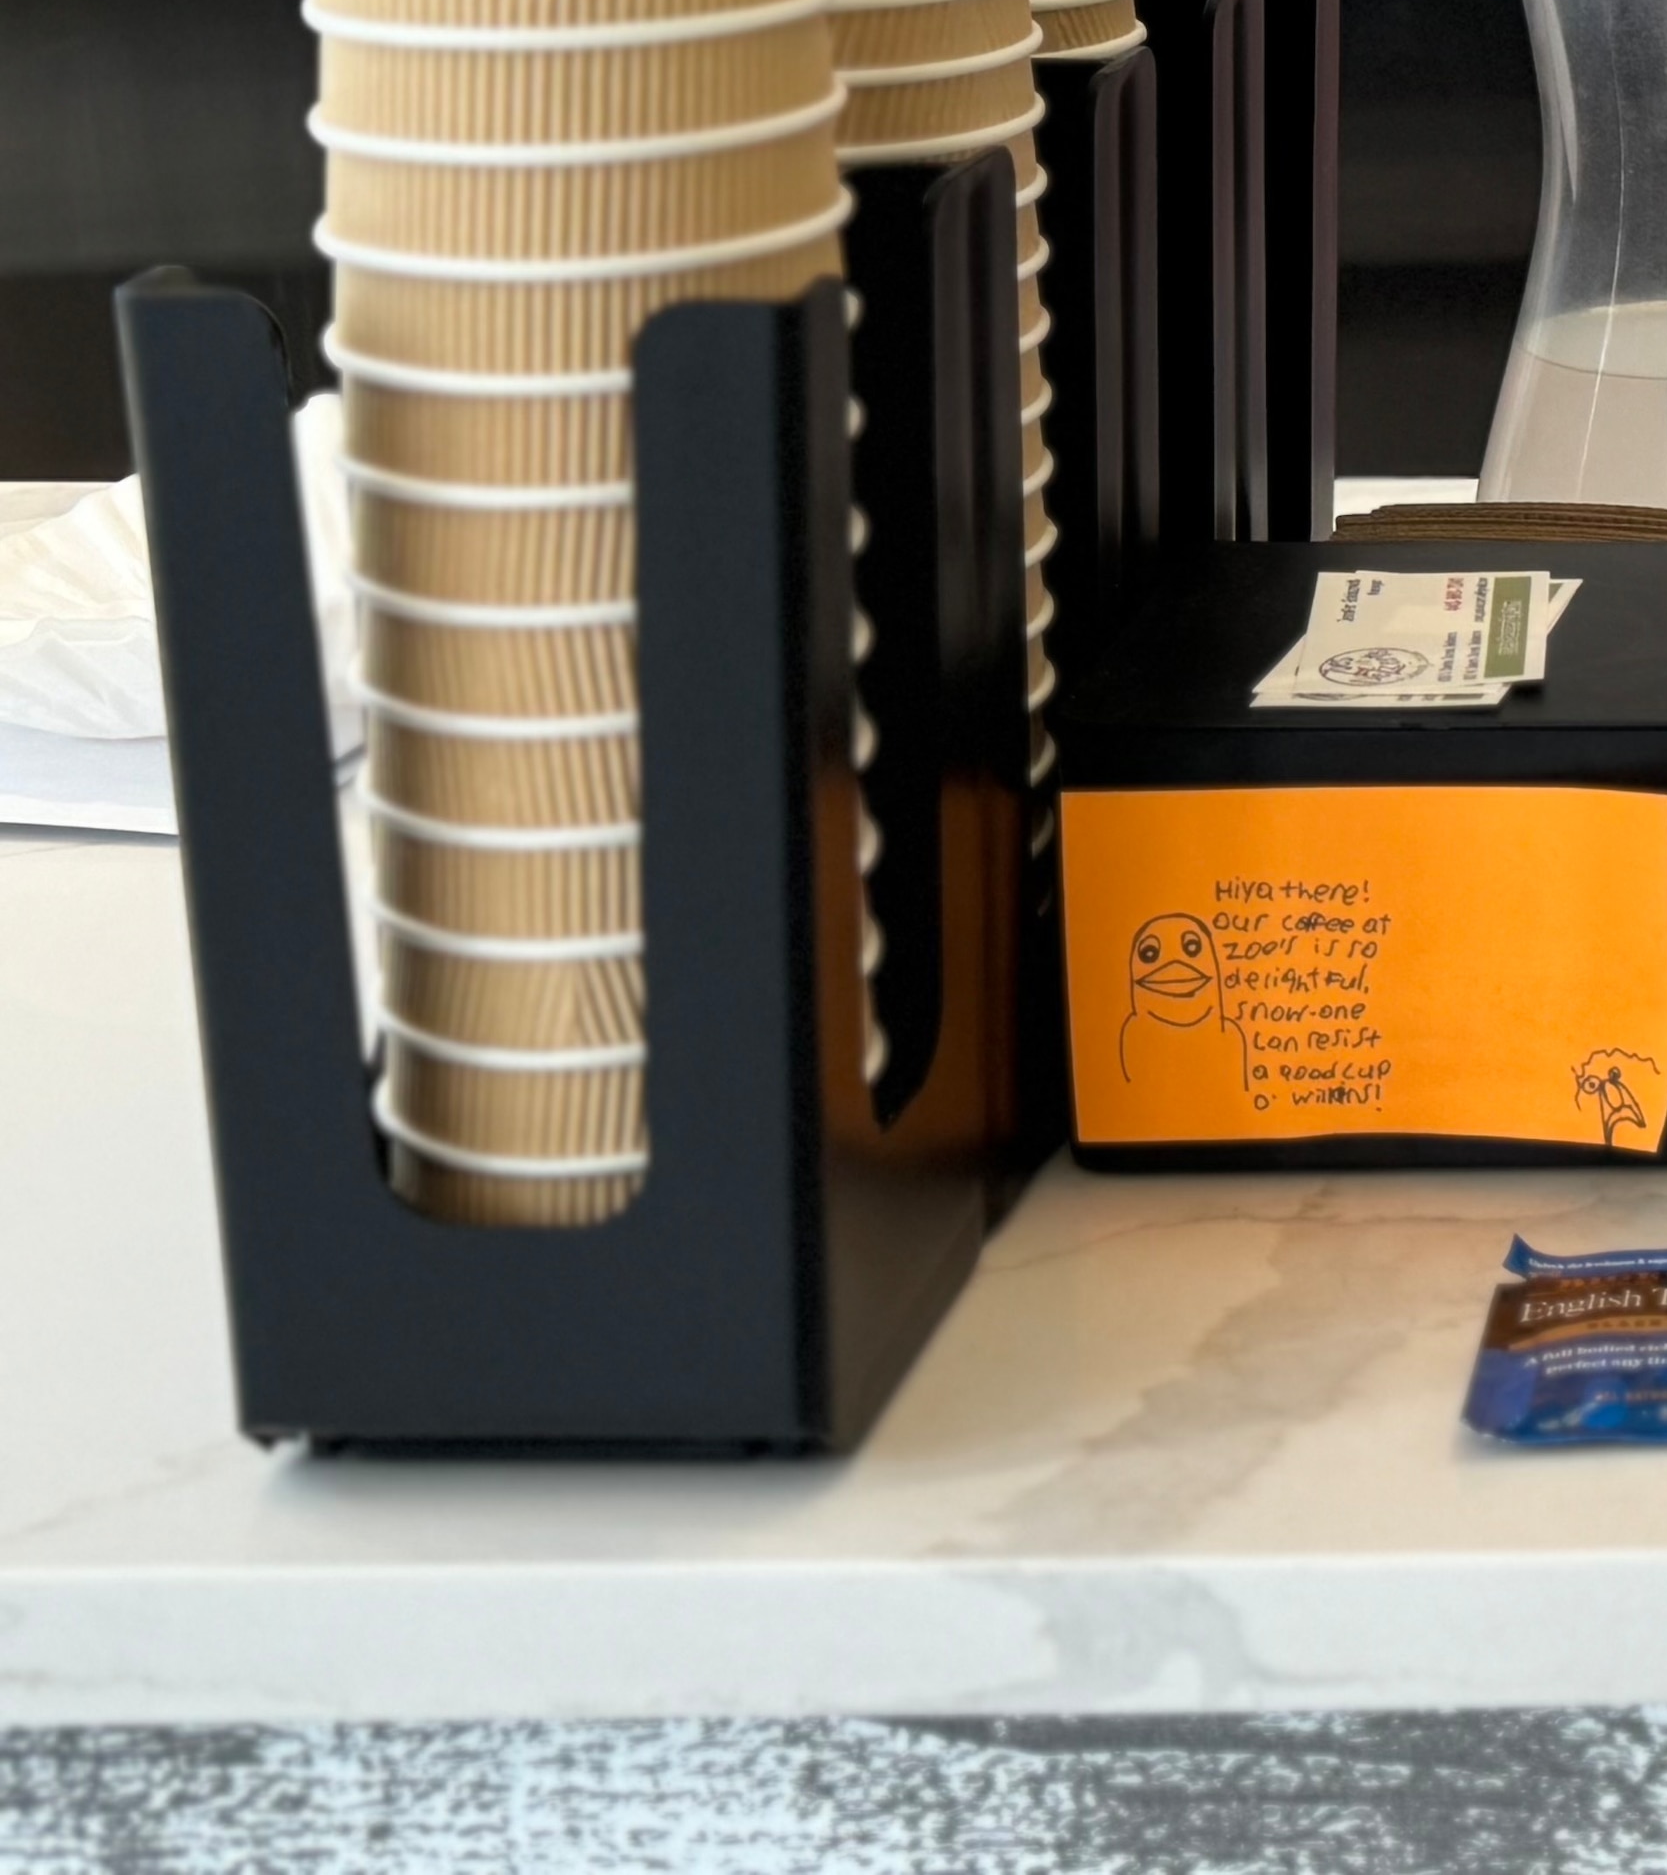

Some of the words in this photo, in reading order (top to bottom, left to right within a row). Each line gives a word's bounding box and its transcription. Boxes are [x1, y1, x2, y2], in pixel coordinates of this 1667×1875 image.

[1215, 877, 1274, 903] Hiya
[1361, 913, 1392, 934] at
[1314, 938, 1339, 957] is
[1347, 939, 1379, 959] so
[1253, 1031, 1299, 1052] can
[1308, 1026, 1383, 1052] resist
[1252, 1064, 1270, 1081] a
[1280, 1060, 1339, 1082] good
[1341, 1059, 1393, 1080] cup
[1520, 1288, 1642, 1323] English
